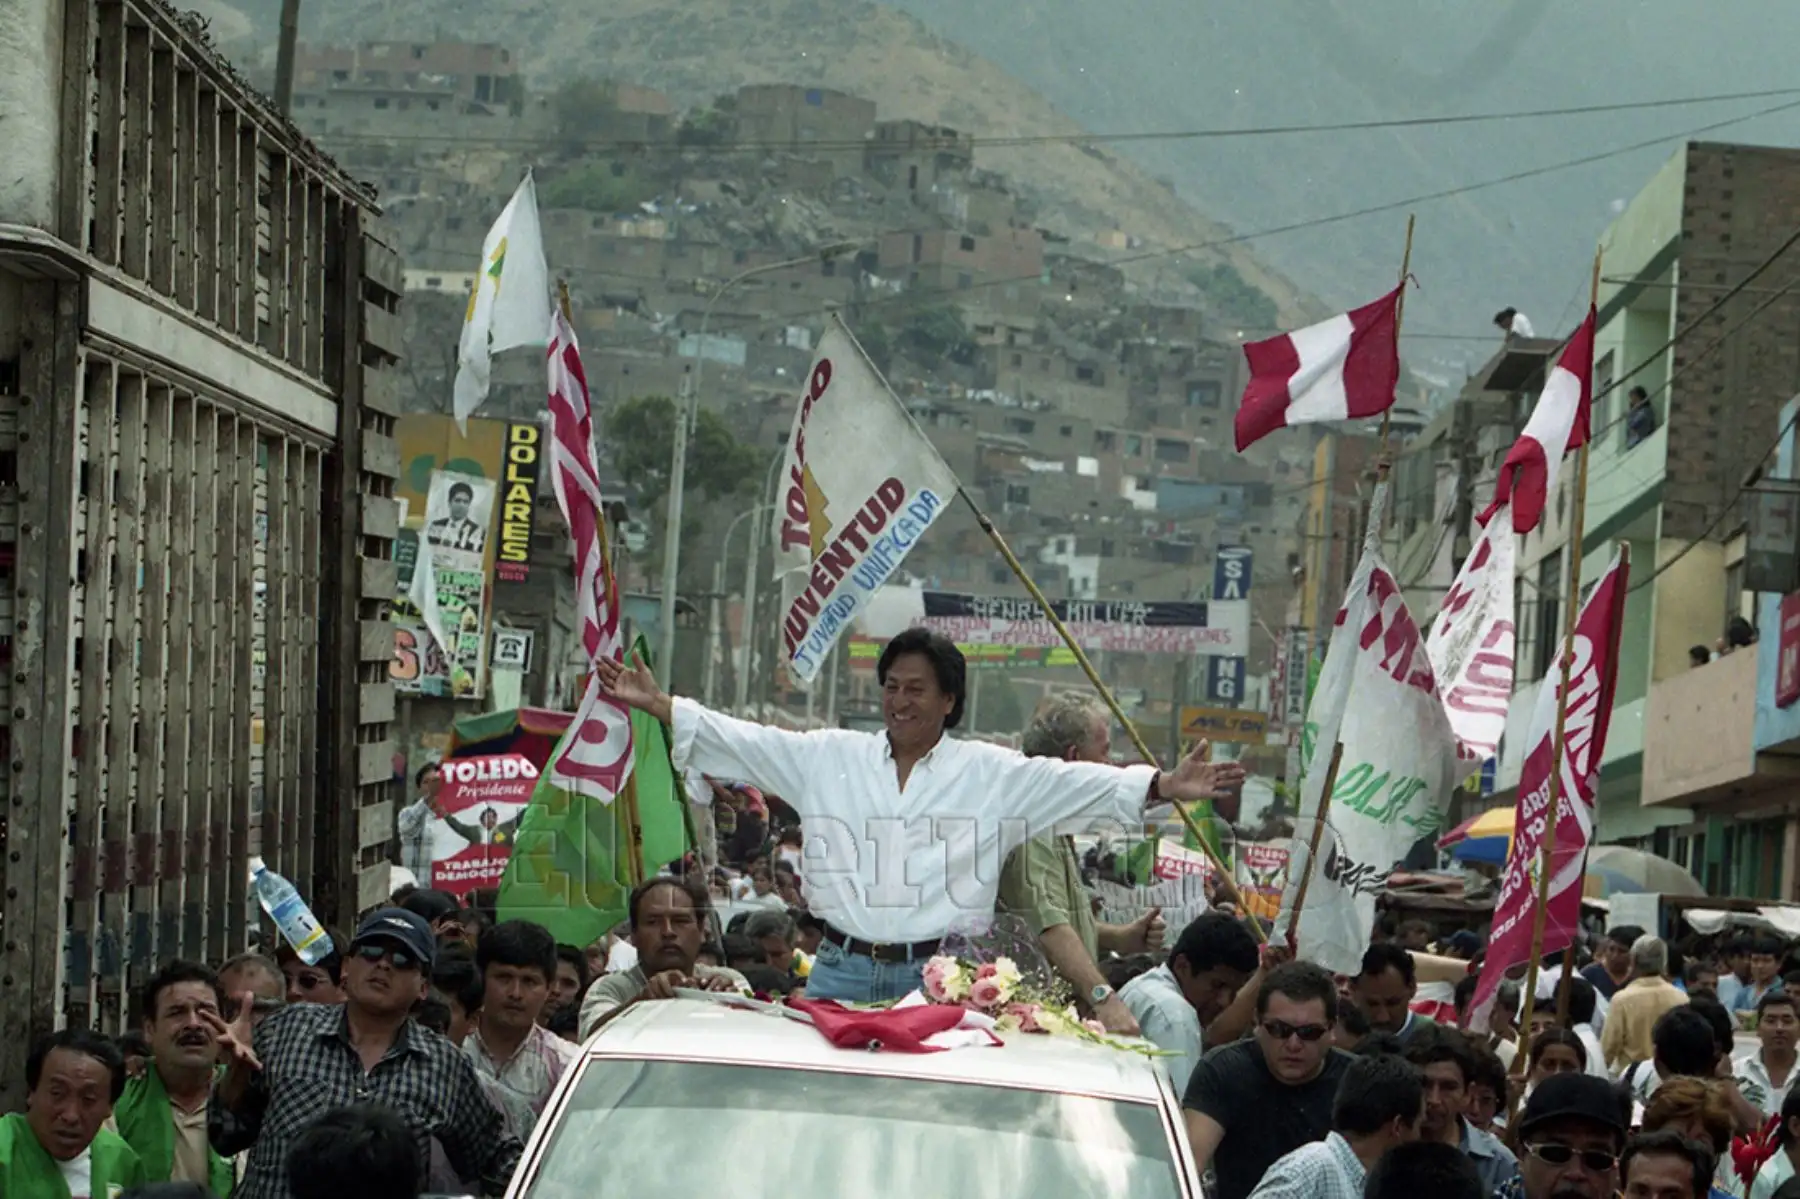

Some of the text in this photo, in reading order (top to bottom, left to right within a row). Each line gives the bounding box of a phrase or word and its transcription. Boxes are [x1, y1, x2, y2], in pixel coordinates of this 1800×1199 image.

[500, 424, 538, 562] DOLARES
[783, 477, 906, 661] JUVENTUD
[852, 487, 942, 591] UNIFICADA
[442, 757, 539, 785] TOLEDO
[456, 782, 526, 798] Presidente
[443, 857, 509, 871] TRABAJO
